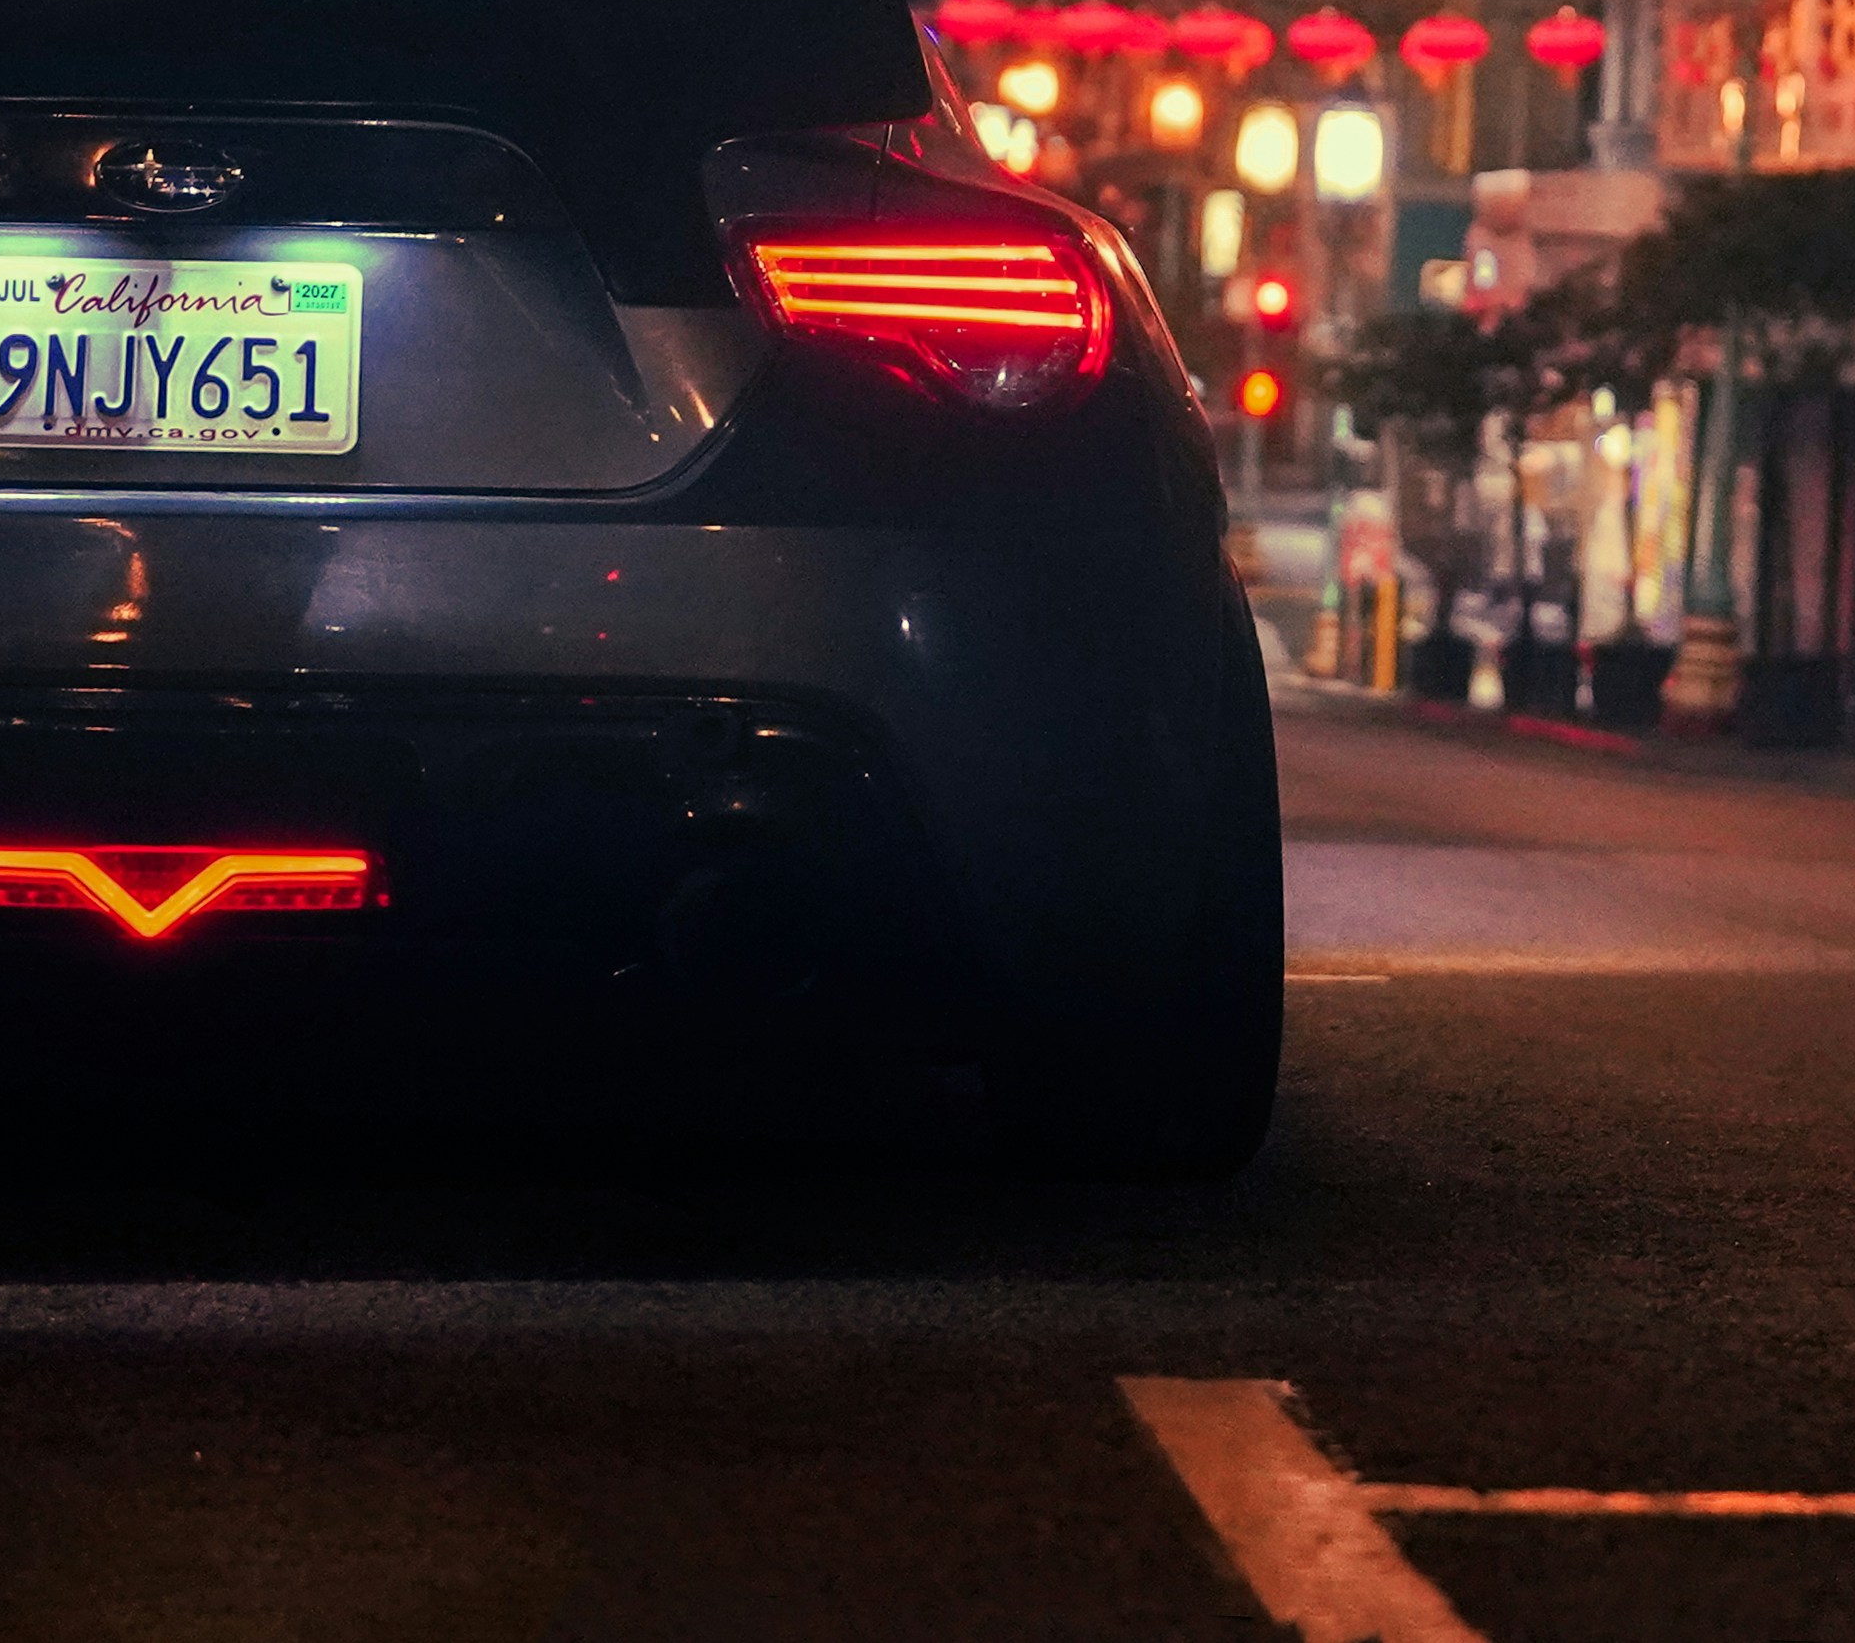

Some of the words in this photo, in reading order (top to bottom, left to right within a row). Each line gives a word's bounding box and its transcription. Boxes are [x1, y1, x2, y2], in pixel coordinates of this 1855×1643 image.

[54, 273, 289, 329] California
[301, 284, 339, 299] 2027
[64, 423, 260, 442] dmv.ca.gov
